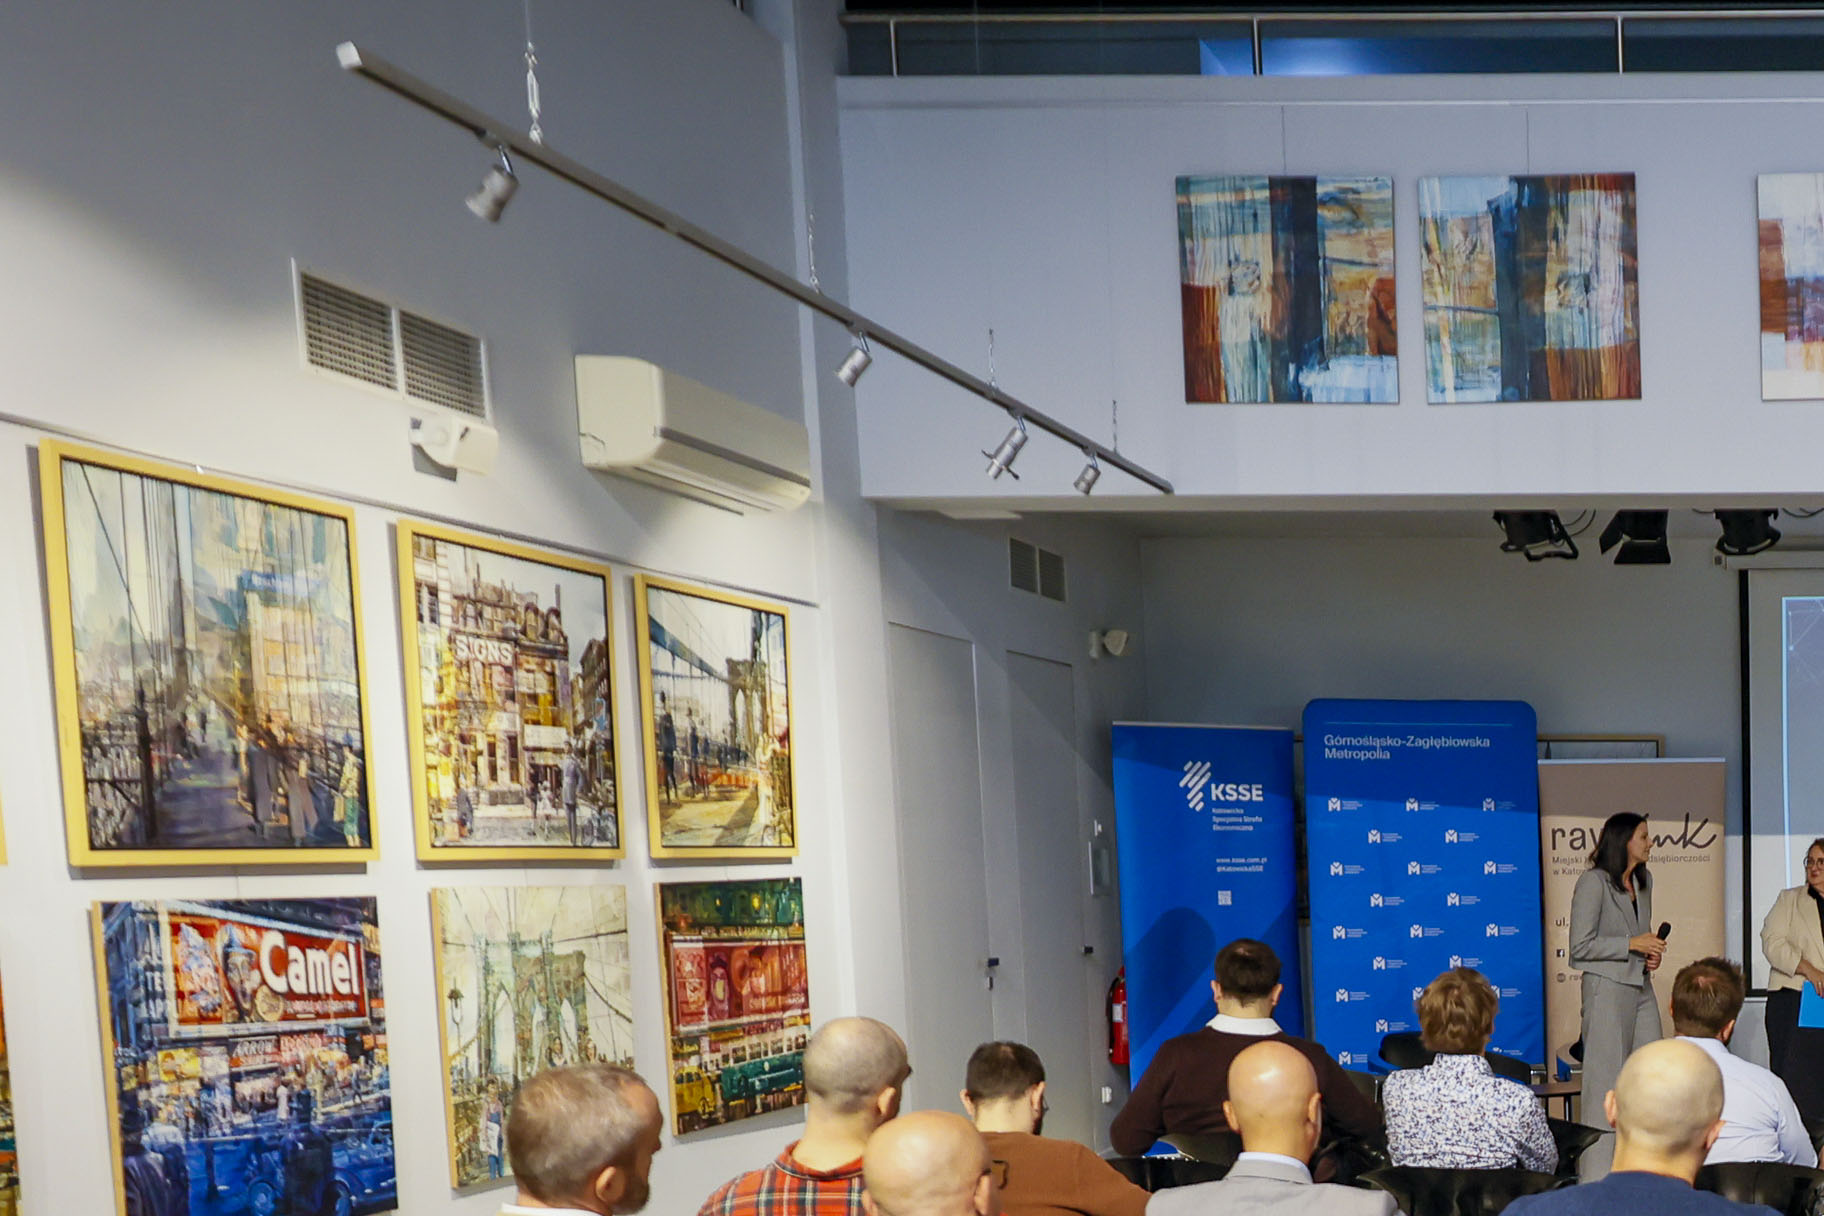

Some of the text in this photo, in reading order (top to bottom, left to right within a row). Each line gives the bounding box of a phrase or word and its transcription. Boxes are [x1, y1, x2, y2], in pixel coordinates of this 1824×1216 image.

[455, 634, 514, 667] SIGNS
[1324, 735, 1490, 749] Górnośląsko-Zagłębiowska
[1325, 748, 1391, 761] Metropolia
[1211, 783, 1264, 802] KSSE
[1555, 917, 1569, 927] ul.
[260, 930, 360, 996] Camel
